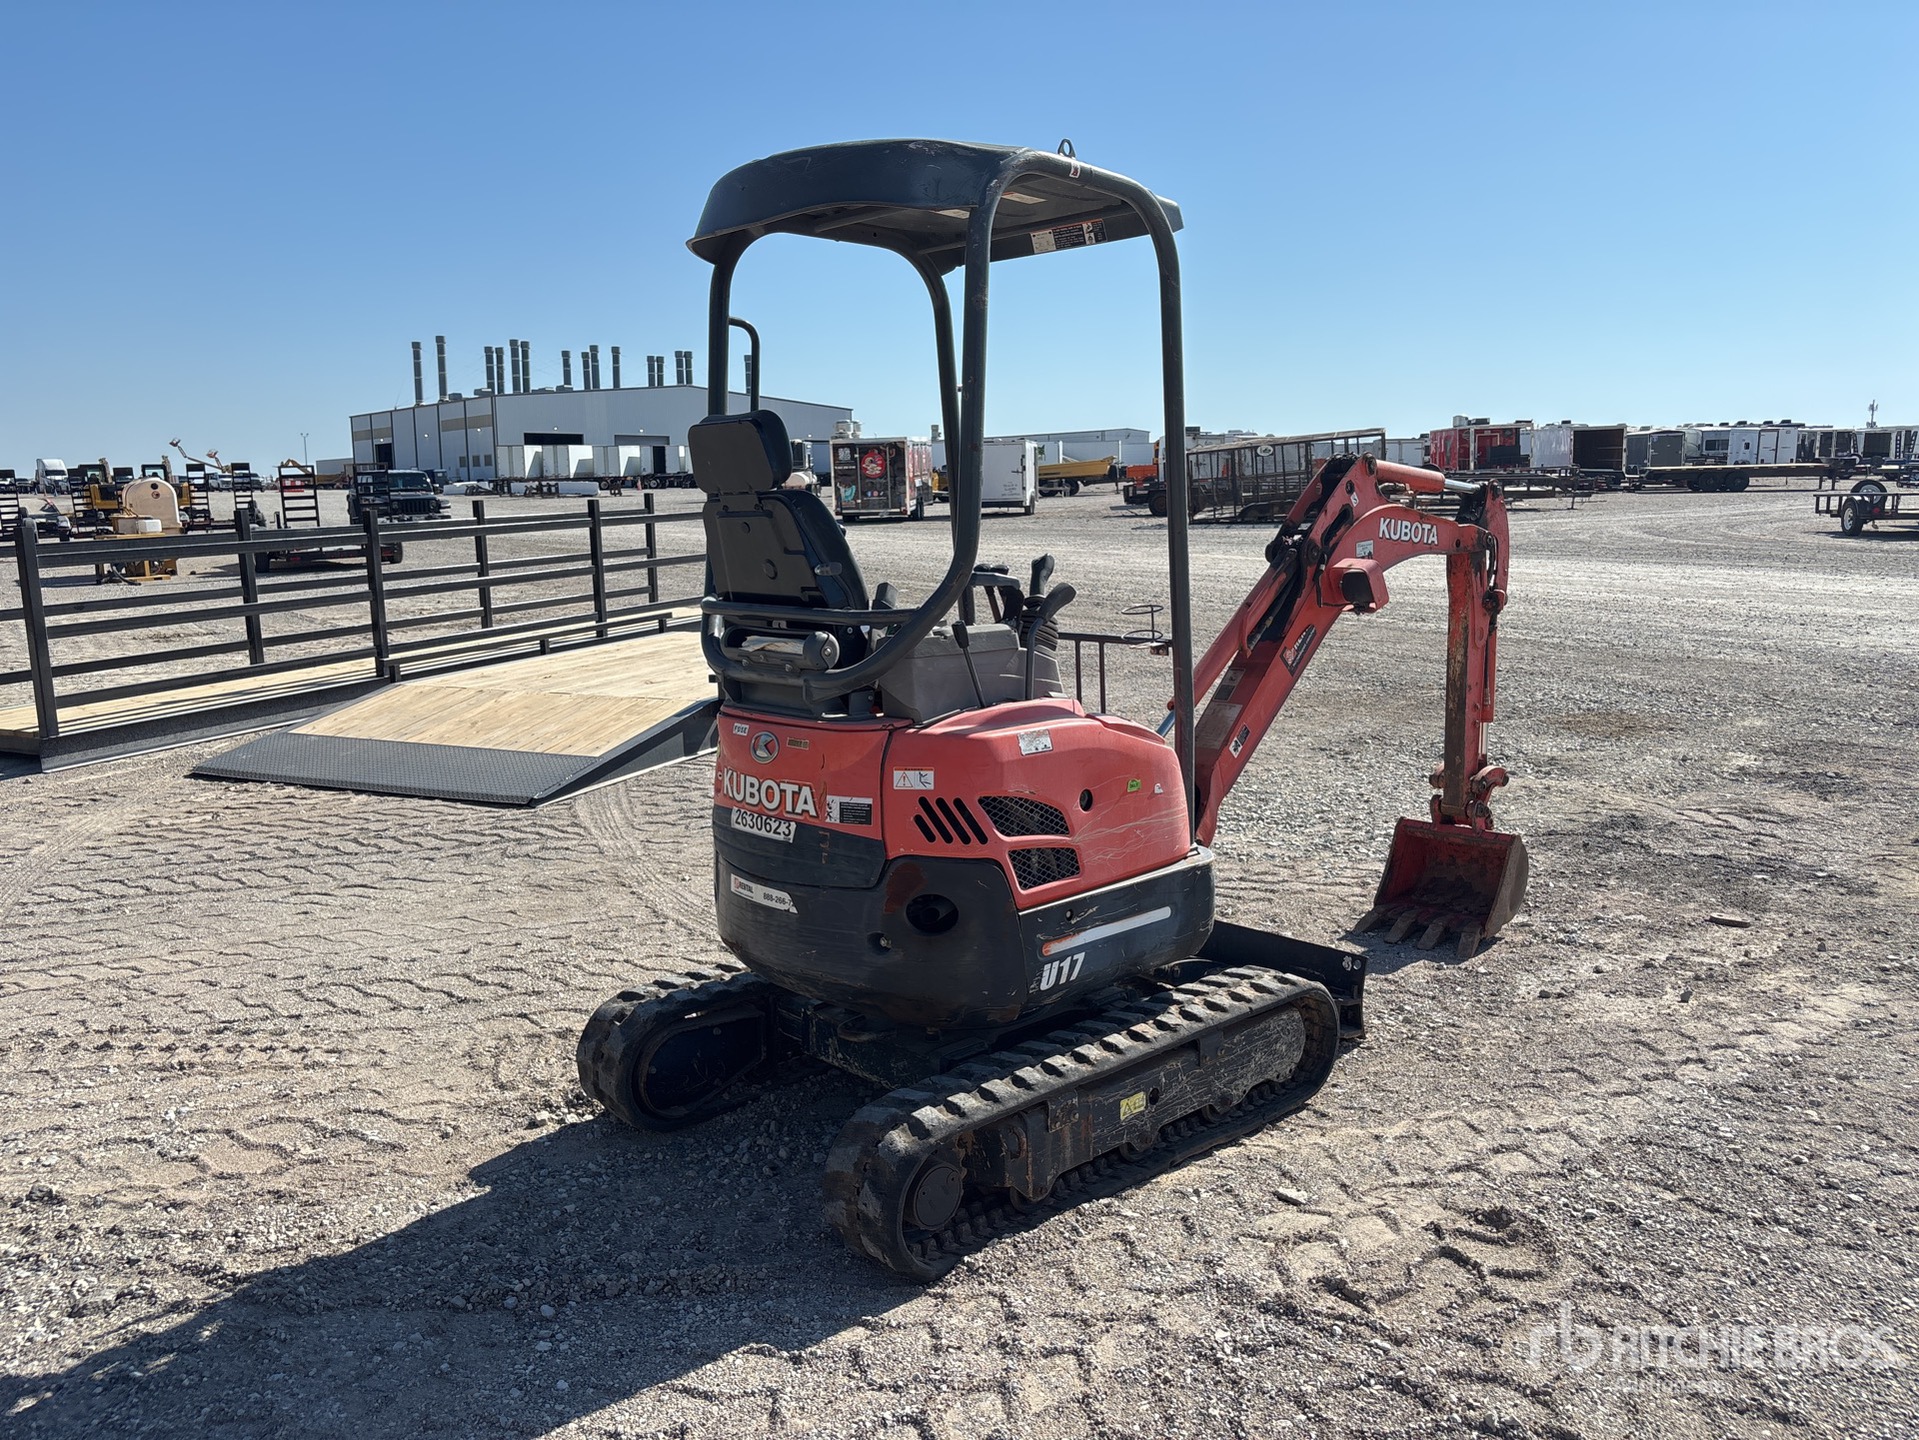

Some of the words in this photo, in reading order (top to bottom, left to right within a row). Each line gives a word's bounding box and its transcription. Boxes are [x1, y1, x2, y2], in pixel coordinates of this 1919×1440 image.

[1379, 517, 1438, 545] KUBOTA
[734, 724, 748, 735] FUSE
[723, 767, 819, 817] KUBOTA
[735, 808, 793, 837] 2630623
[1040, 952, 1086, 991] U17
